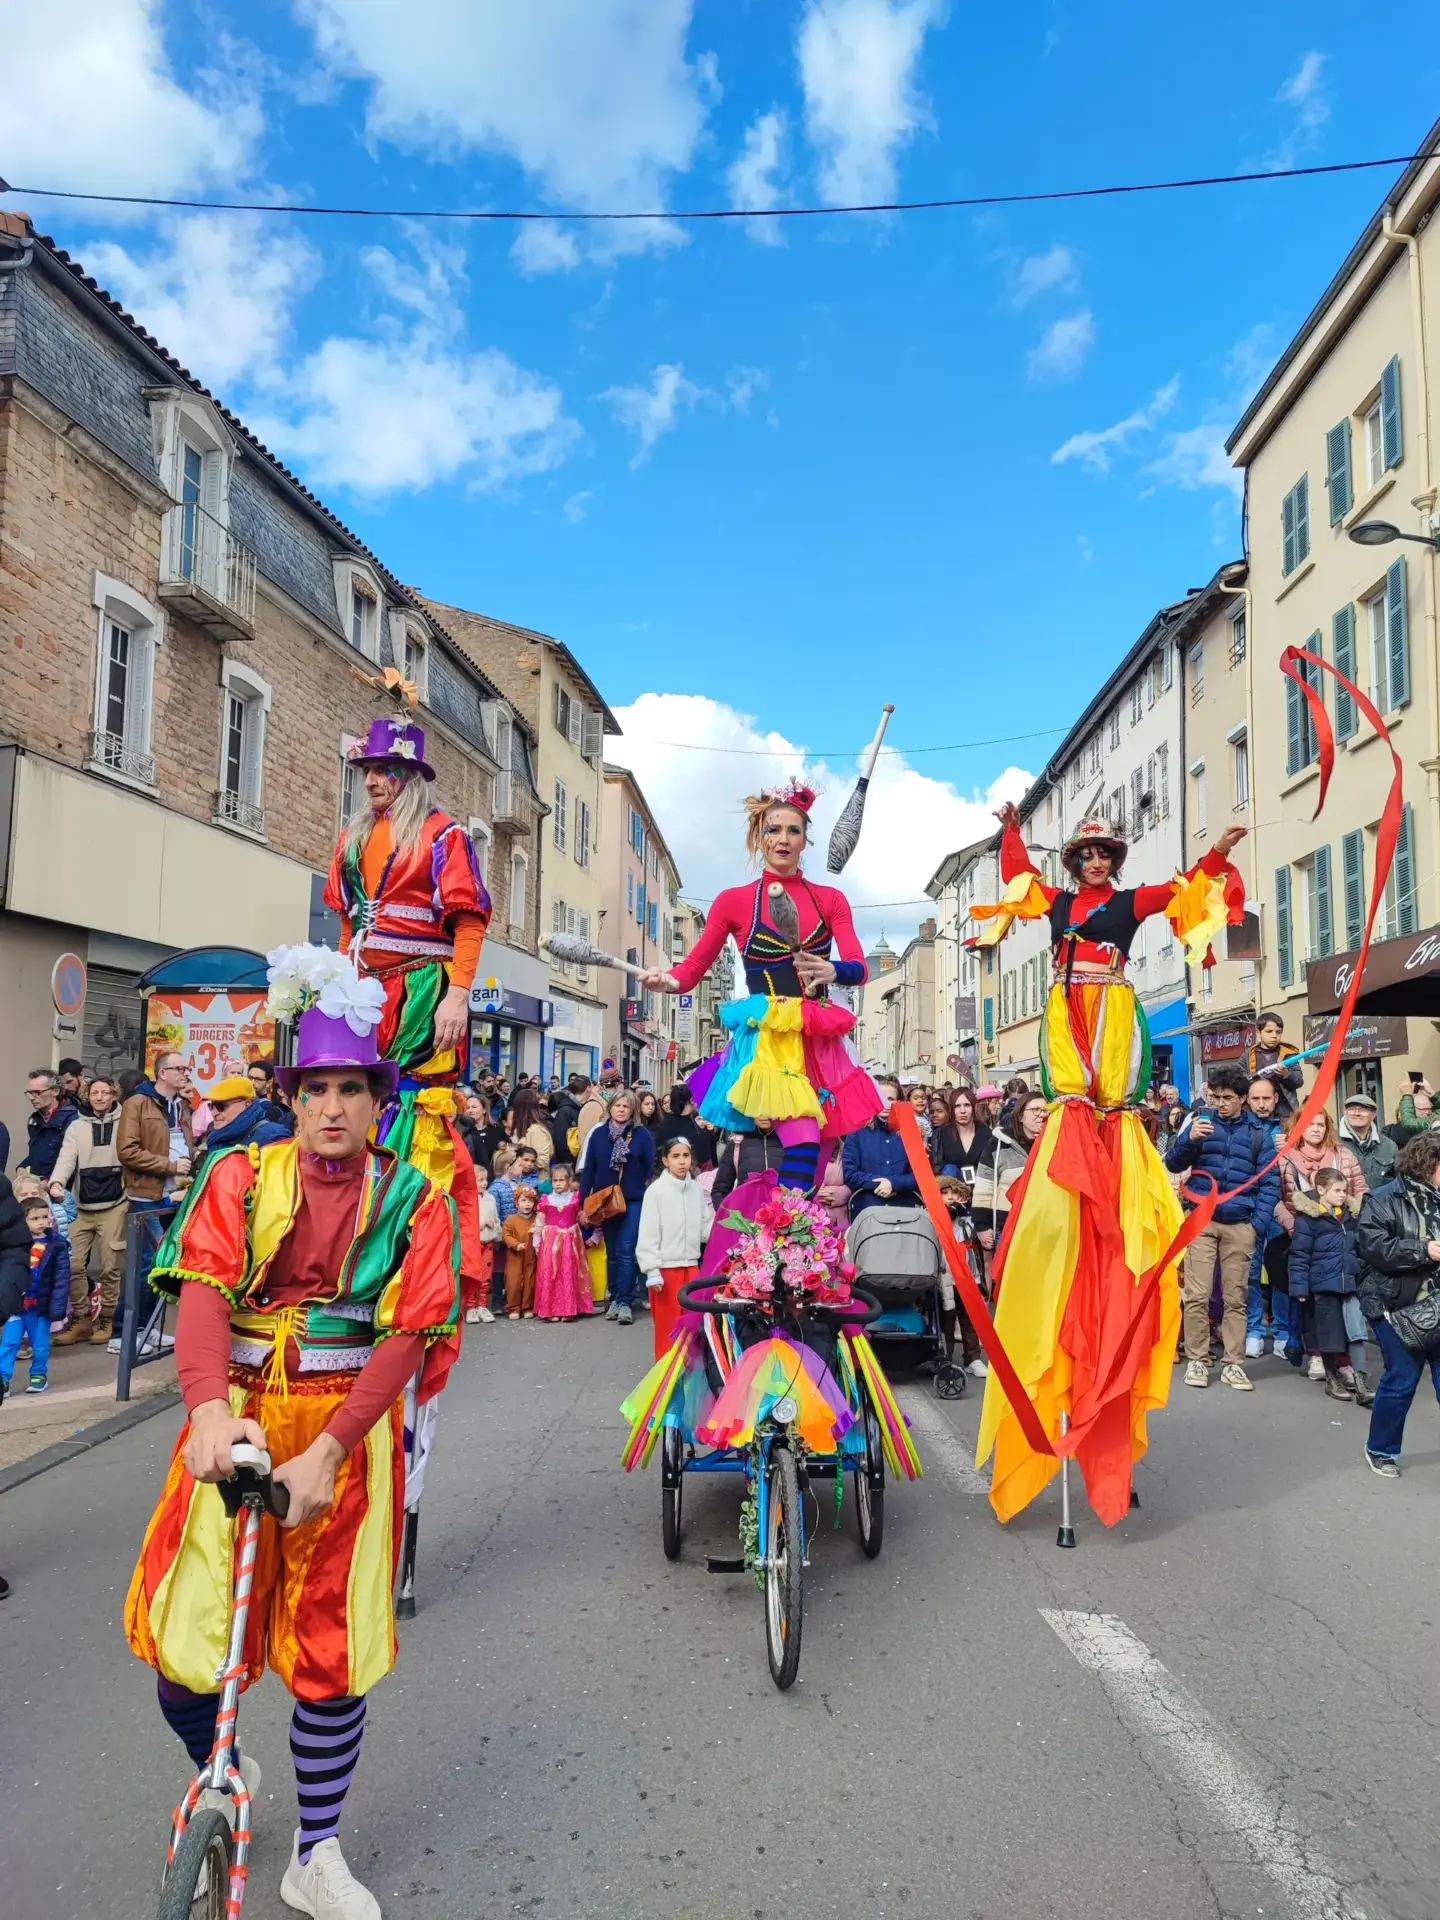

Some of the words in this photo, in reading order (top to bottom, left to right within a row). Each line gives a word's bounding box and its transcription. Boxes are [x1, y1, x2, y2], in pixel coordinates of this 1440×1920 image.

[472, 988, 499, 1002] gan
[190, 1029, 234, 1041] BURGERS
[189, 1052, 195, 1069] À
